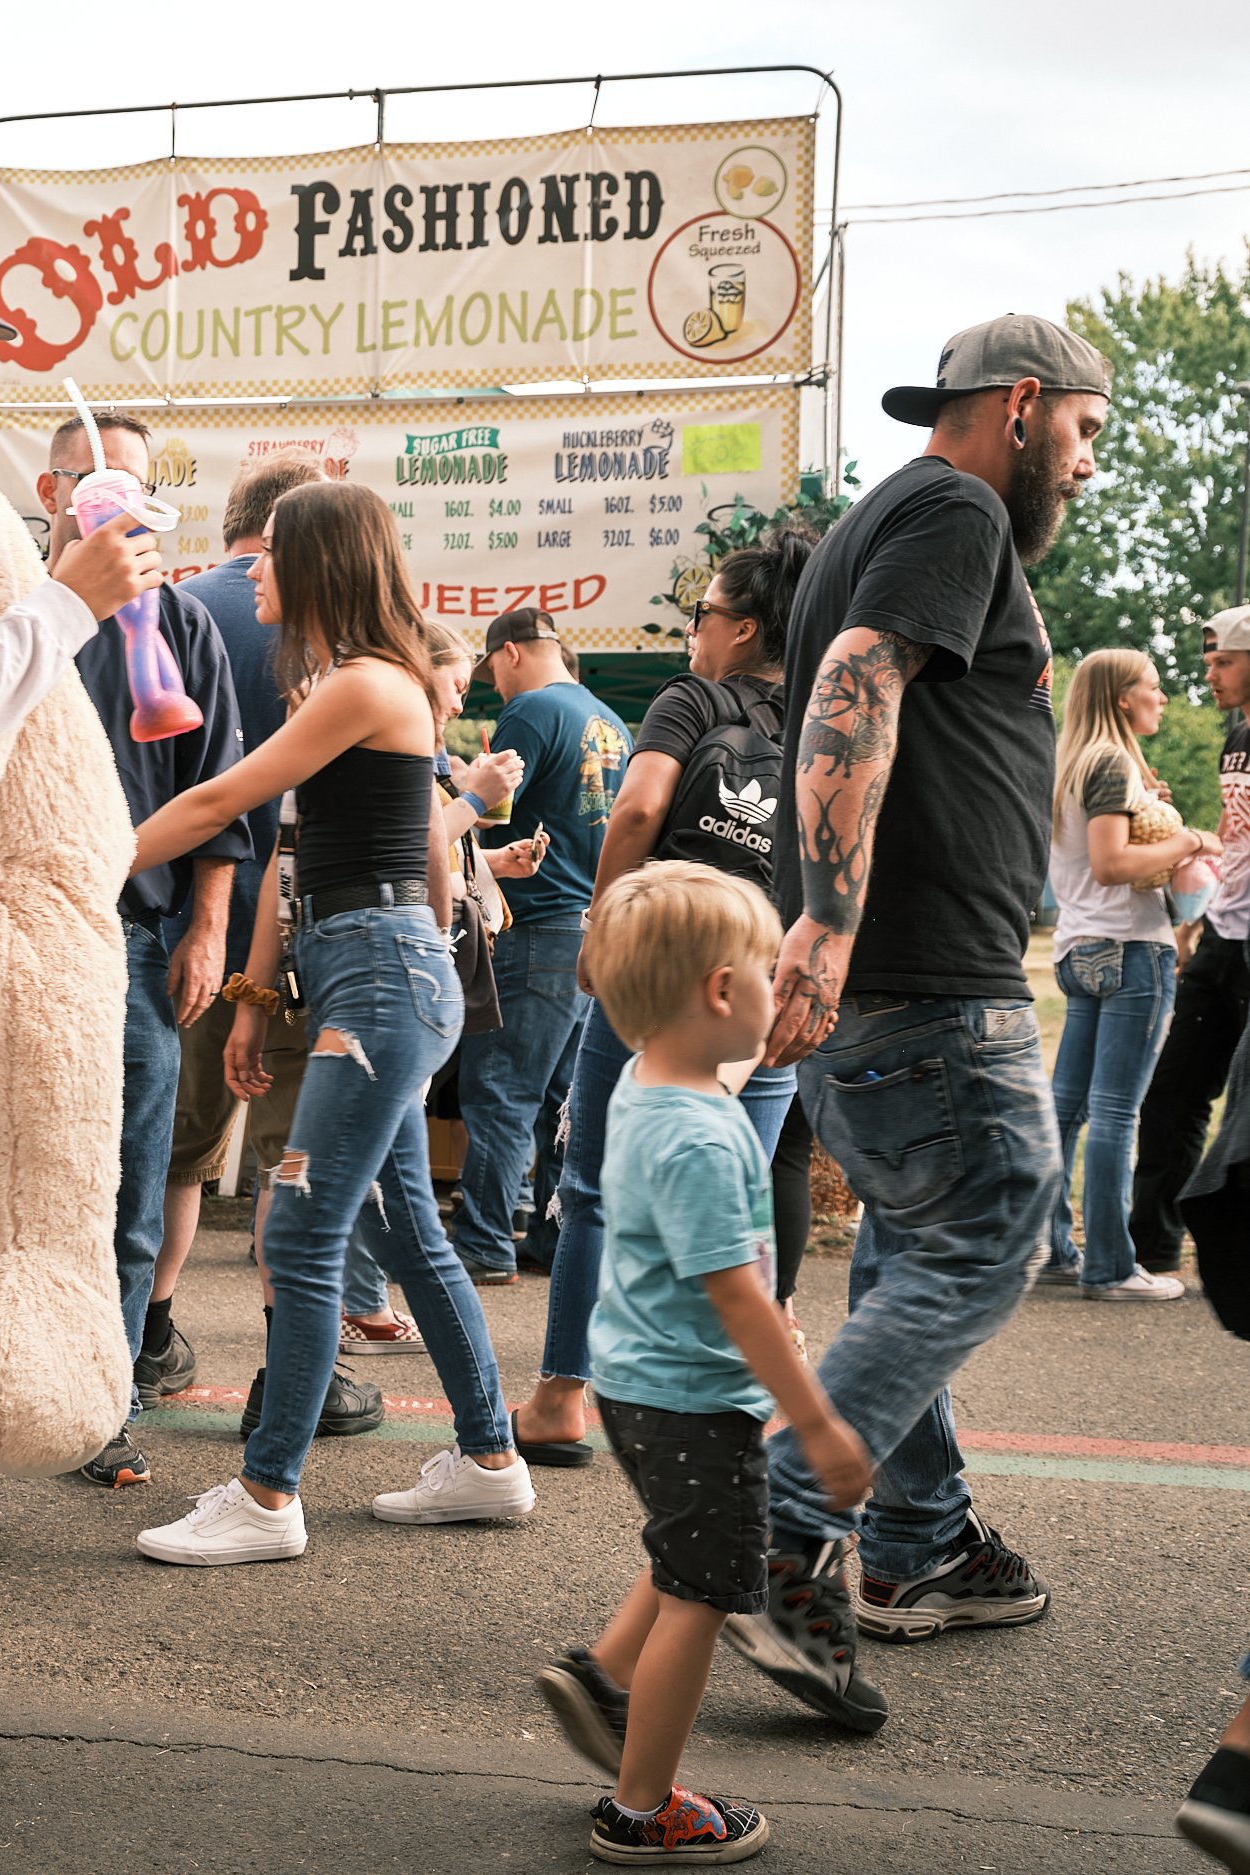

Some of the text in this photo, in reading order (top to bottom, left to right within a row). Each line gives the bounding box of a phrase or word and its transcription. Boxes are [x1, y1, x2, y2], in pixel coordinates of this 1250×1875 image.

[291, 170, 664, 280] FASHIONED
[698, 224, 755, 242] Fresh
[689, 242, 761, 261] Squeezed
[111, 288, 636, 363] COUNTRY LEMONADE
[413, 428, 491, 456] SUGAR FREE
[563, 429, 644, 448] HUCKLEBERRY
[396, 453, 508, 486] LEMONADE
[555, 448, 670, 483] LEMONADE
[489, 498, 521, 517] $4.00
[539, 498, 574, 515] SMALL
[650, 493, 682, 514] $5.00
[178, 536, 209, 554] $4.00
[489, 531, 518, 550] $5.00
[538, 530, 572, 548] LARGE
[650, 527, 680, 547] $6.00
[699, 815, 772, 853] adidas
